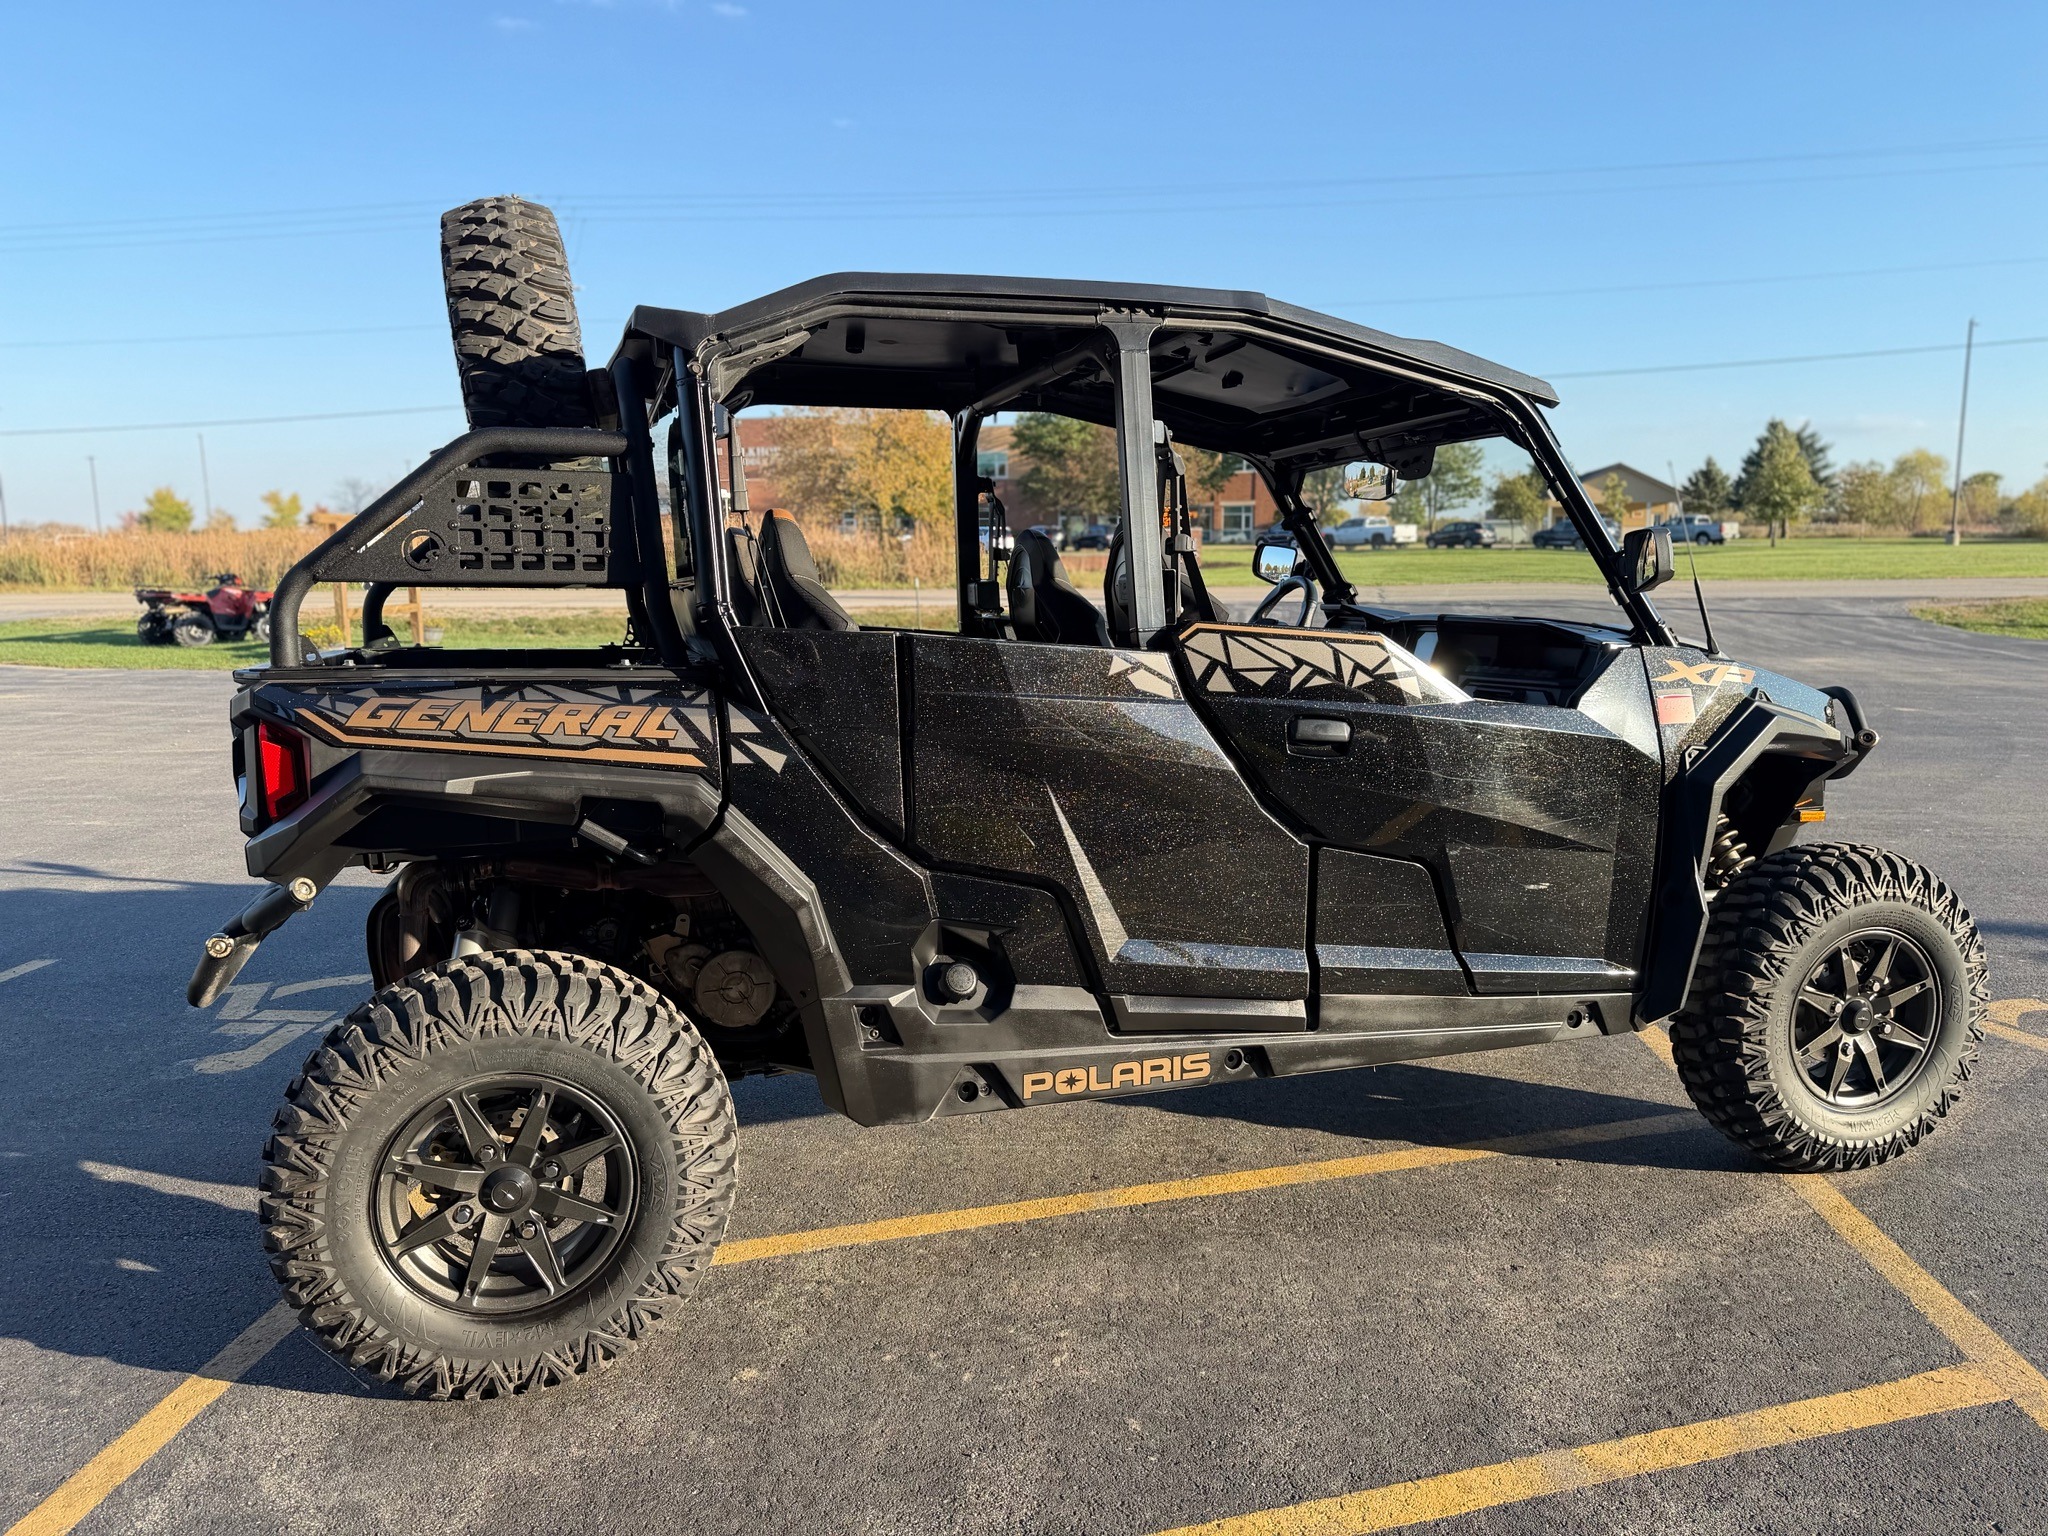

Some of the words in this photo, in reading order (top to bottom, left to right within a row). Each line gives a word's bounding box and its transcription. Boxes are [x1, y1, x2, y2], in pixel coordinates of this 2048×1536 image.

[1651, 660, 1756, 687] XP
[344, 696, 679, 740] GENERAL
[1023, 1052, 1212, 1100] POLARIS
